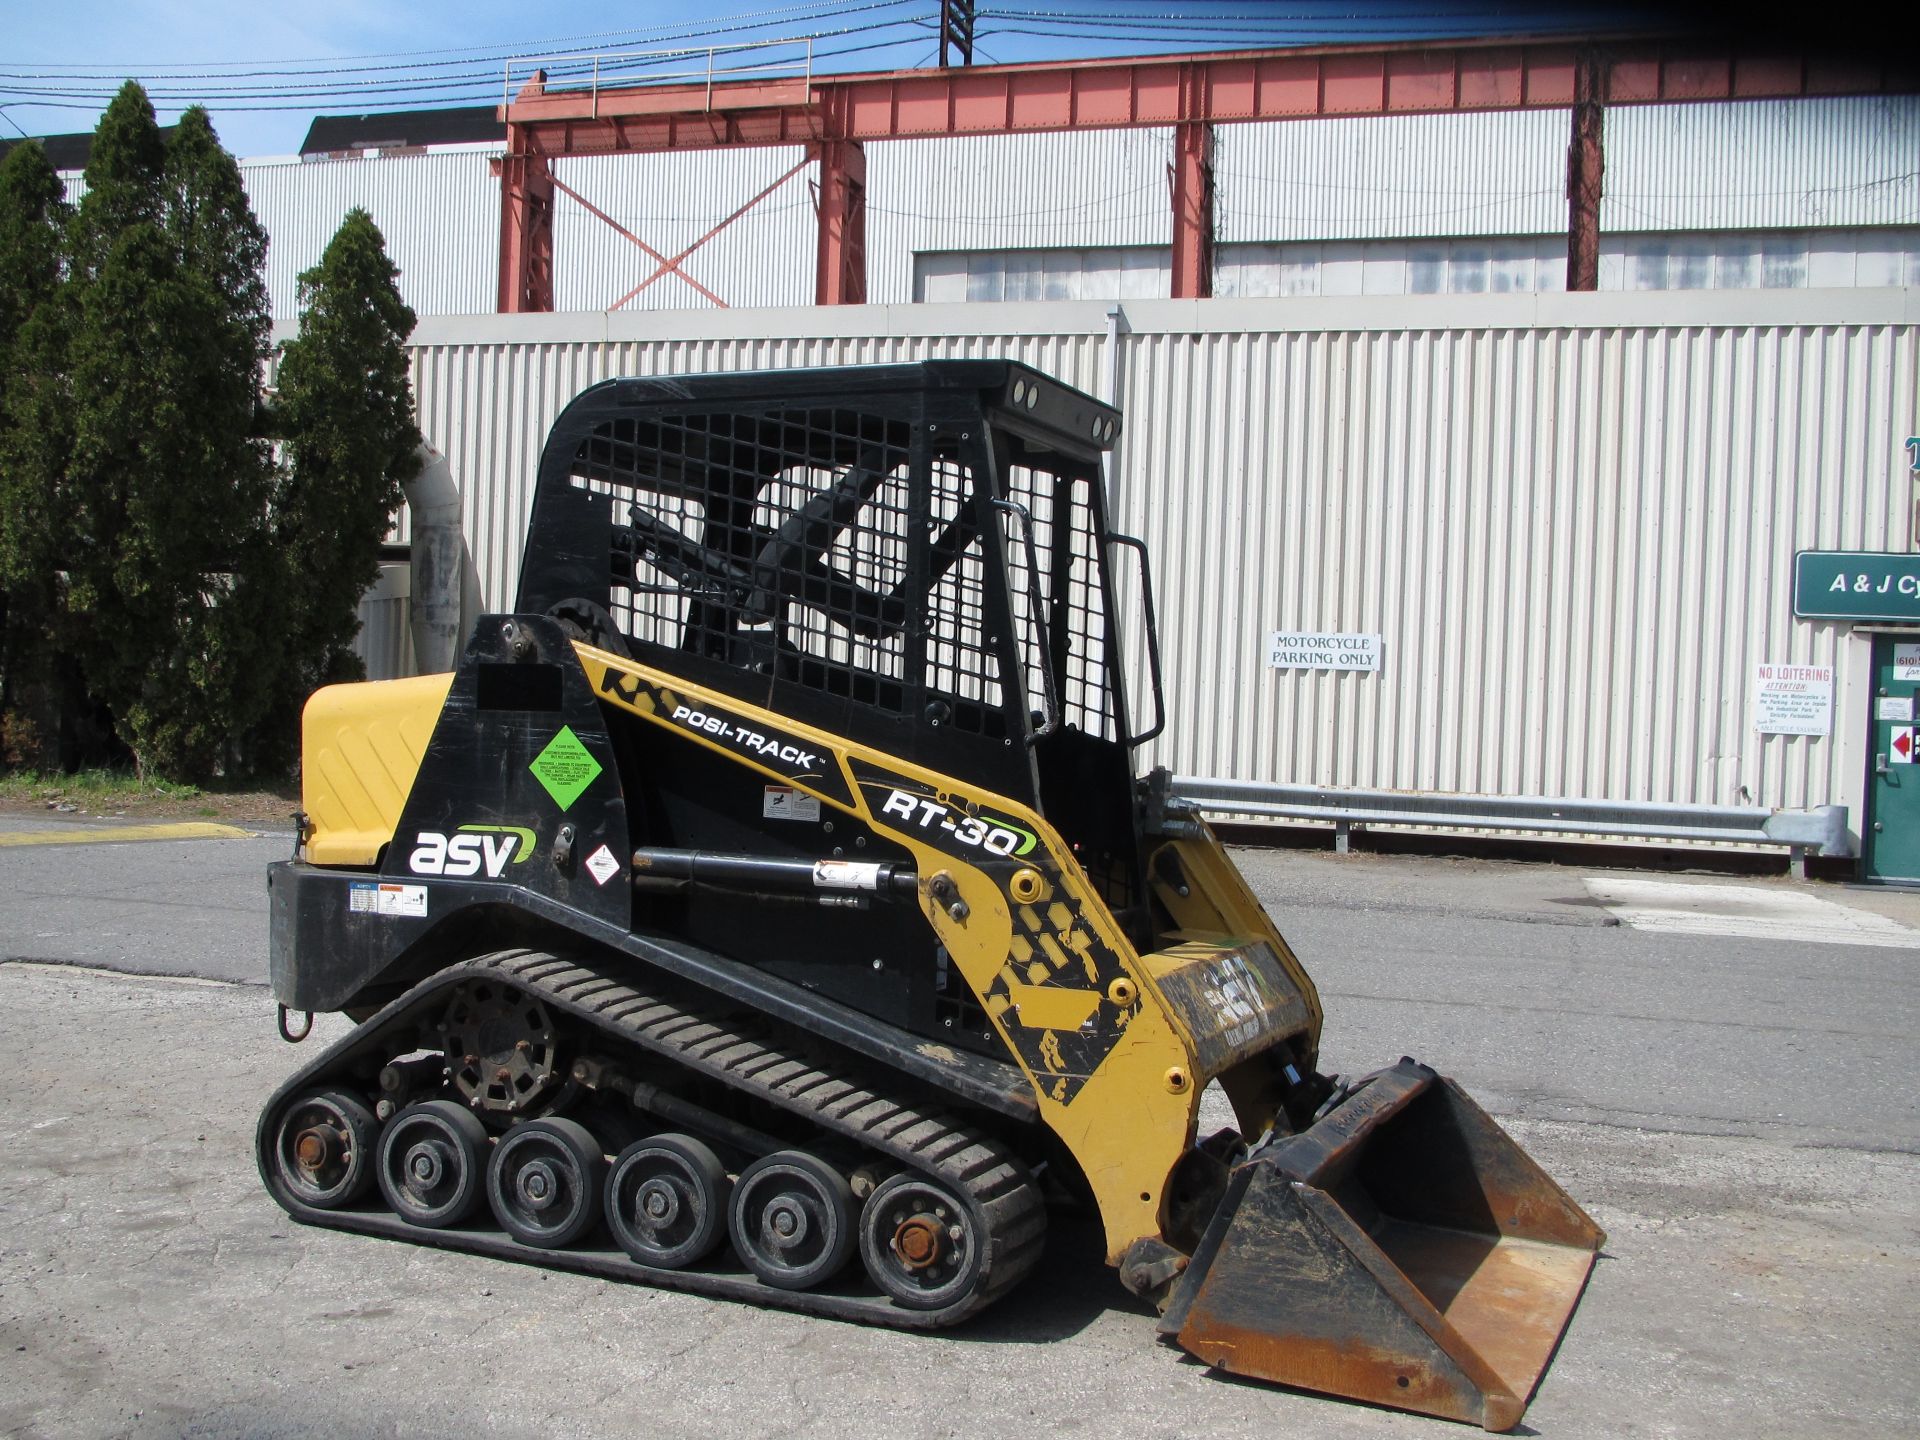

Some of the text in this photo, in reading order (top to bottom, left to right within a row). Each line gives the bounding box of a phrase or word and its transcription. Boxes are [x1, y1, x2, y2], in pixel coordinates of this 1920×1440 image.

[1829, 573, 1847, 592] A
[1853, 574, 1870, 593] &
[1876, 575, 1892, 593] J
[1277, 636, 1370, 650] MOTORCYCLE
[1272, 651, 1375, 666] PARKING ONLY
[1759, 666, 1830, 681] NO LOITERING
[672, 705, 817, 769] POSI-TRACK
[882, 789, 1018, 856] RT-30
